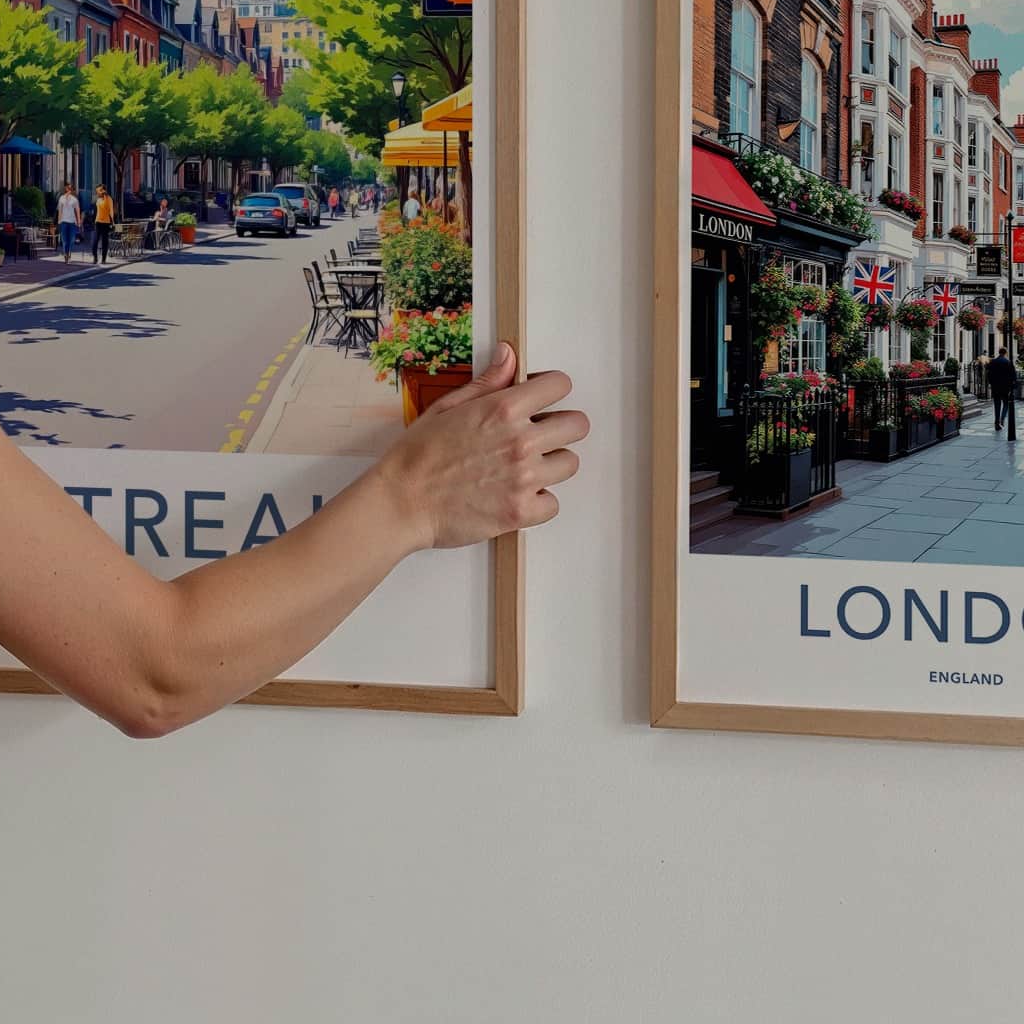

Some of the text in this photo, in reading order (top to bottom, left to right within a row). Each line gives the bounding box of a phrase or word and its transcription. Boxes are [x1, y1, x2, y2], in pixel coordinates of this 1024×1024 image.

[698, 212, 753, 242] LONDON
[63, 486, 323, 560] TREA
[800, 583, 1024, 645] LOND
[929, 670, 1005, 686] ENGLAND
